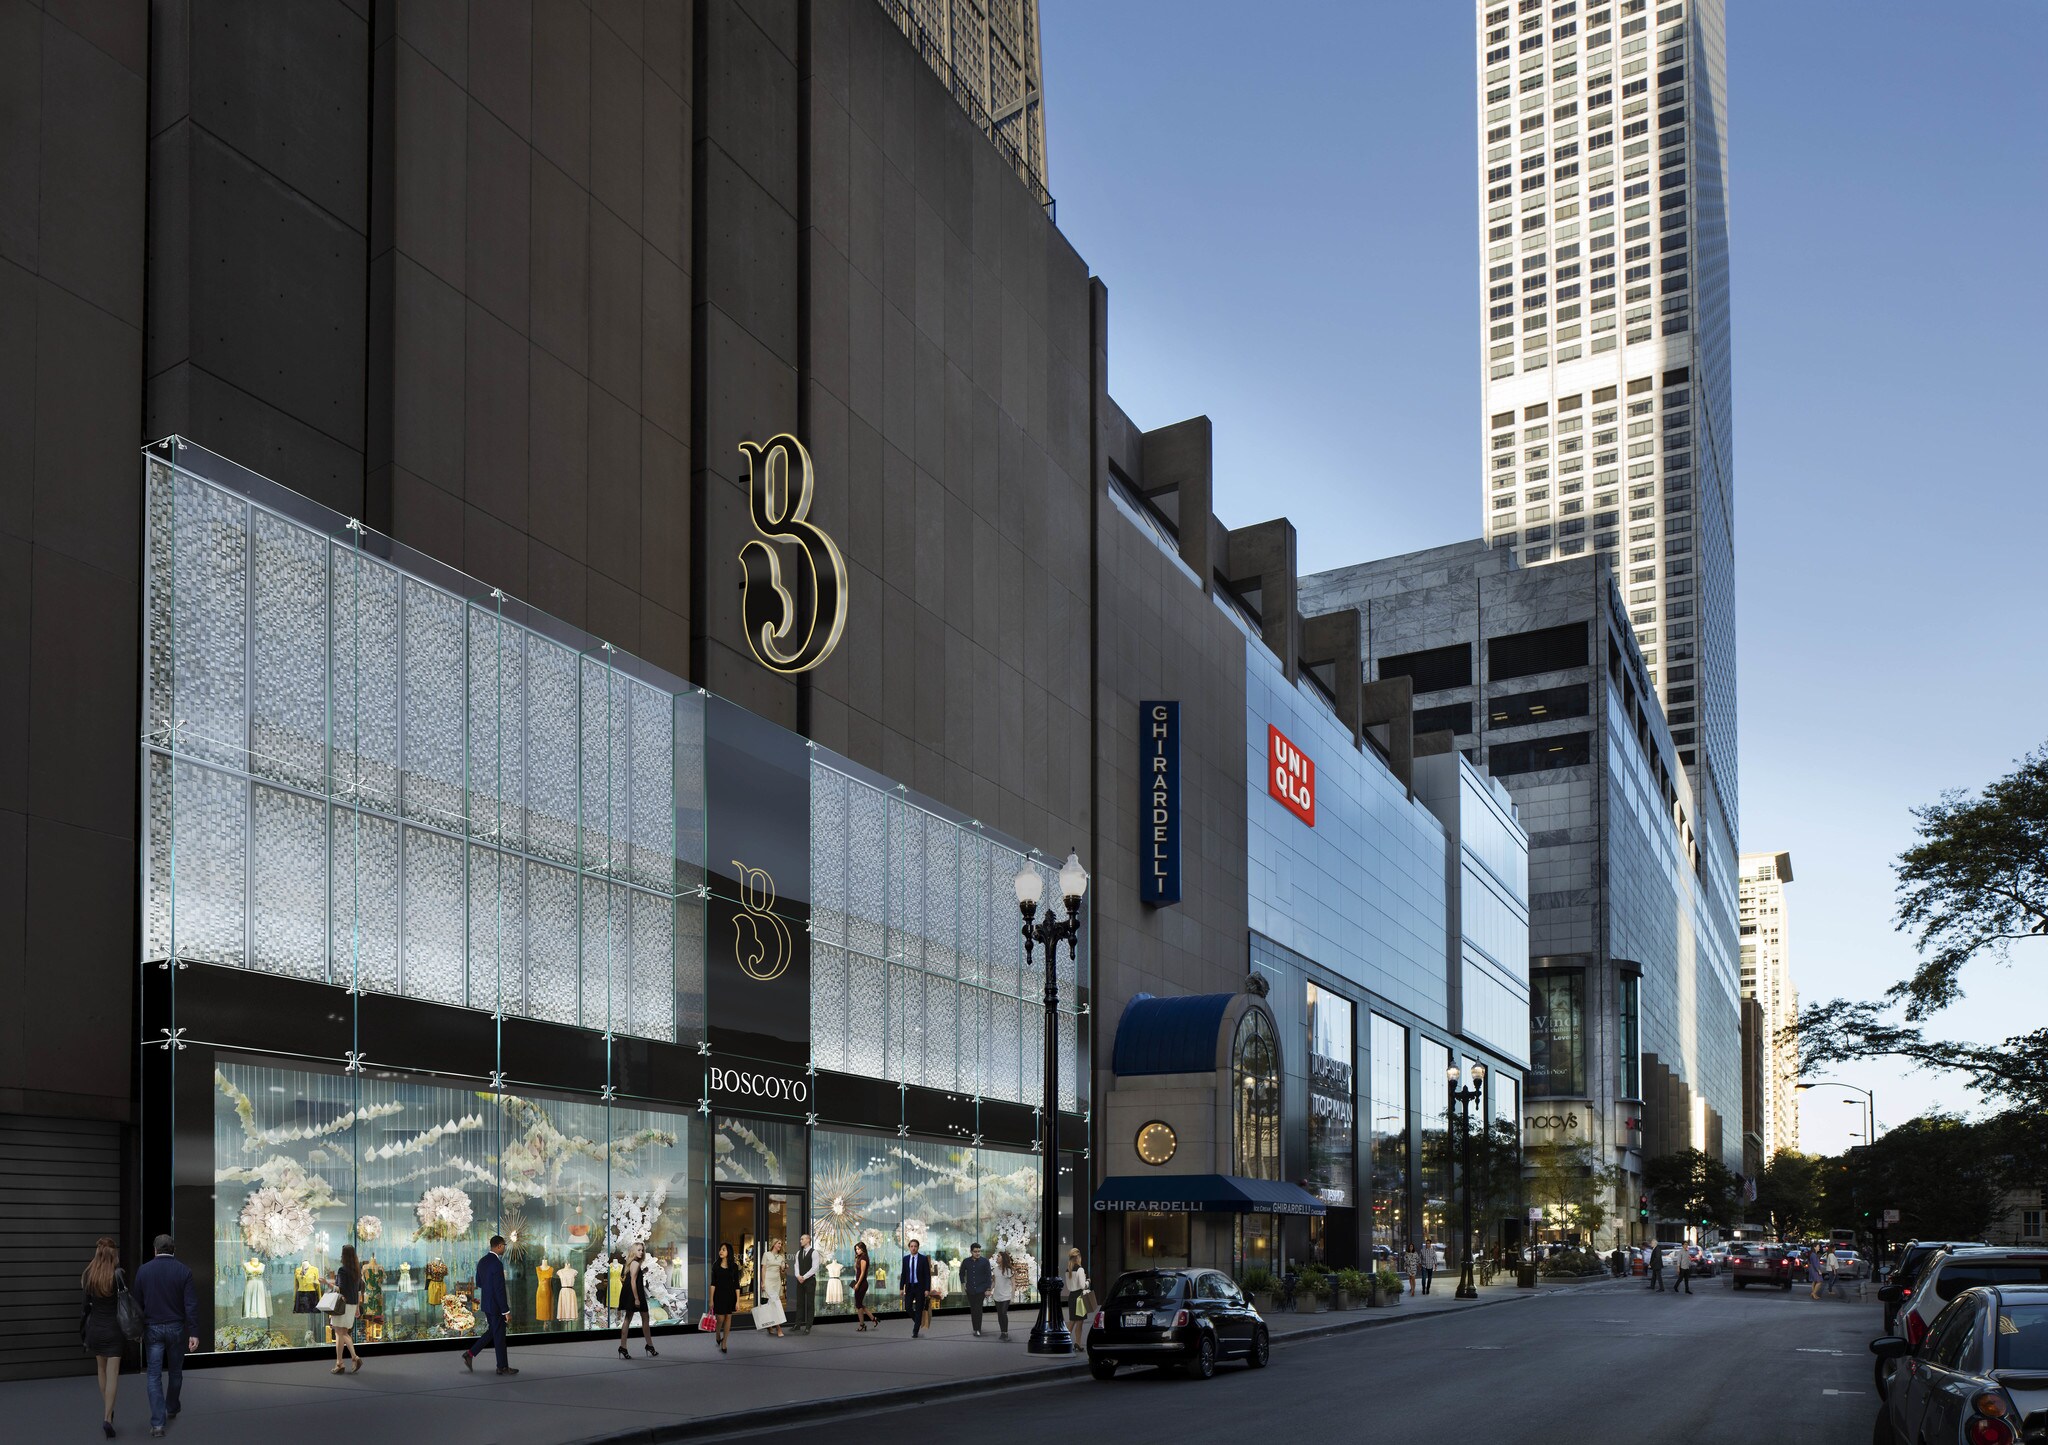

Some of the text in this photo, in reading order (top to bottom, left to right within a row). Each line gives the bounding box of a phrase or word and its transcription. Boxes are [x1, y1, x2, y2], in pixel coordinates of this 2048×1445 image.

[1274, 735, 1308, 785] UNI
[1152, 706, 1169, 894] GHIRARDELLI
[1275, 766, 1311, 811] QLO
[1310, 1050, 1353, 1083] TOPSHOP
[710, 1066, 807, 1102] BOSCOYO
[1311, 1093, 1353, 1123] TOPMAN
[1094, 1200, 1203, 1211] GHIRARDELLI
[1273, 1203, 1311, 1214] GHIRARDELLI
